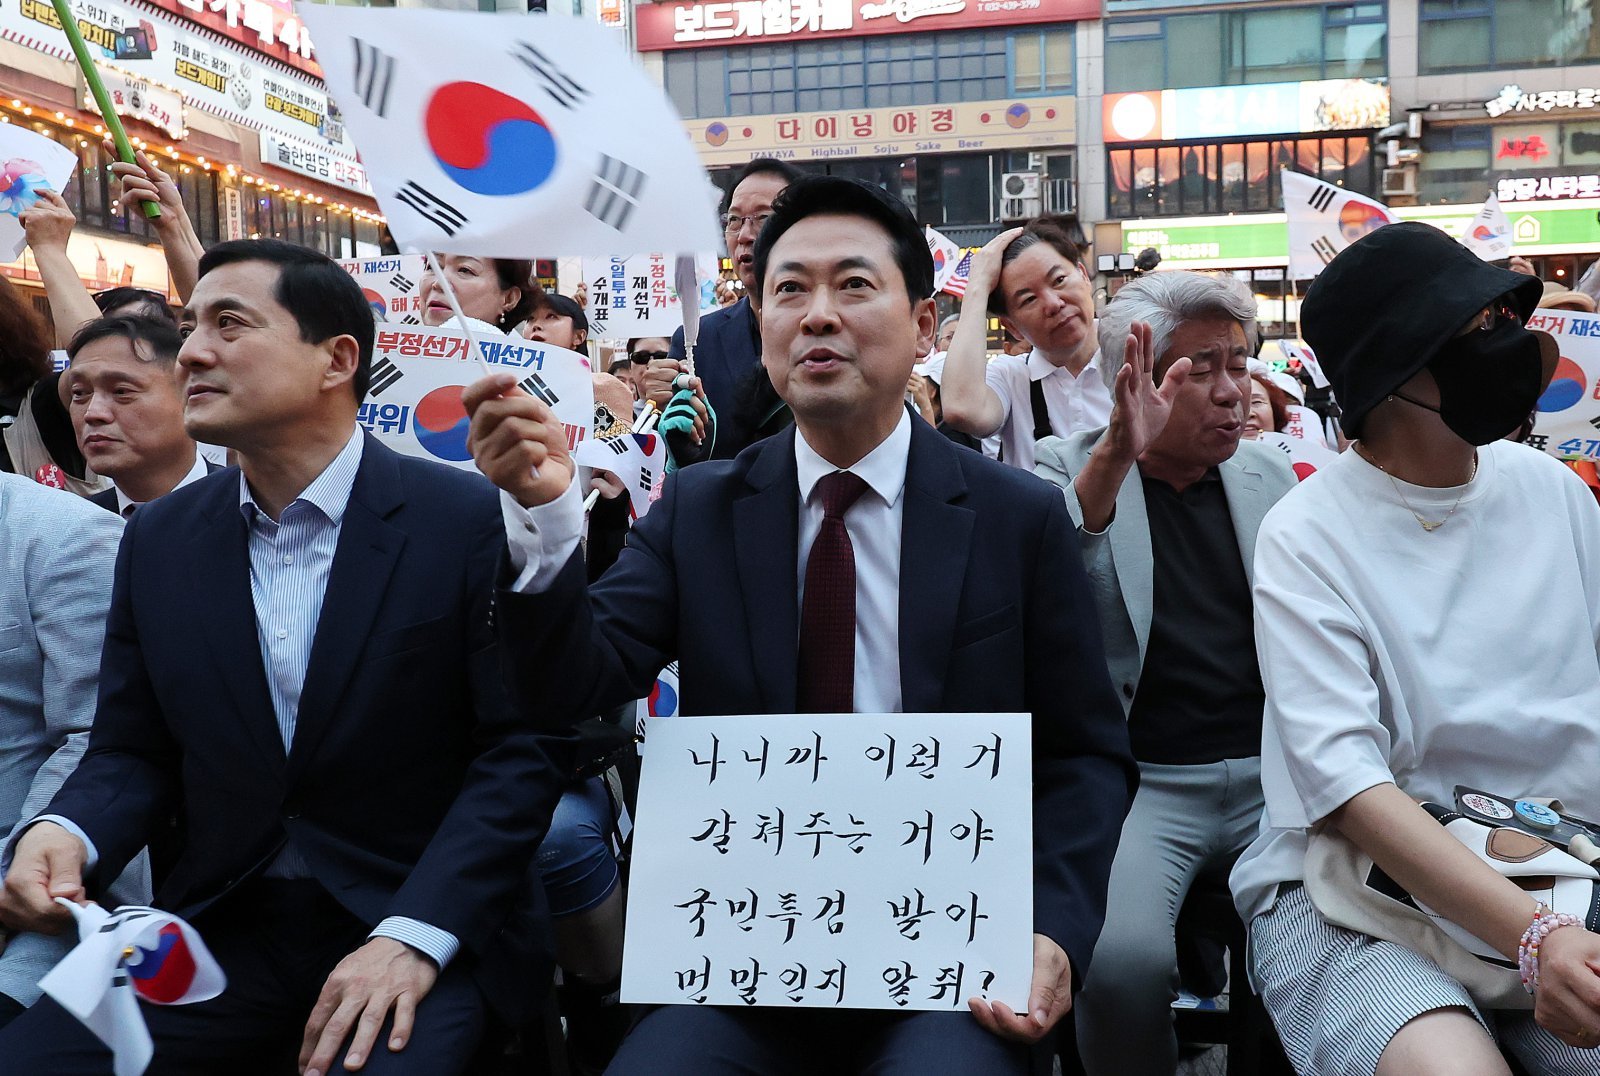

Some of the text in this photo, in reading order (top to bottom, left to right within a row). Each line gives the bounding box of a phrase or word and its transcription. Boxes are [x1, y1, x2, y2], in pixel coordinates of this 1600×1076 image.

[76, 18, 117, 51] 위치!!
[778, 109, 953, 141] 다이닝 야경
[811, 145, 858, 157] Highball
[873, 143, 899, 155] Soju
[915, 141, 941, 151] Sake
[958, 139, 984, 149] Beer
[364, 260, 400, 273] 재선거
[592, 276, 608, 320] 수개표
[632, 276, 649, 320] 재선거
[376, 331, 546, 371] 부정선거 재선거
[686, 730, 1002, 786] 나니까 이런 거
[689, 806, 994, 865] 갈쳐주는 거야
[673, 887, 846, 945] 국민특검
[882, 958, 996, 1007] 알쥐?
